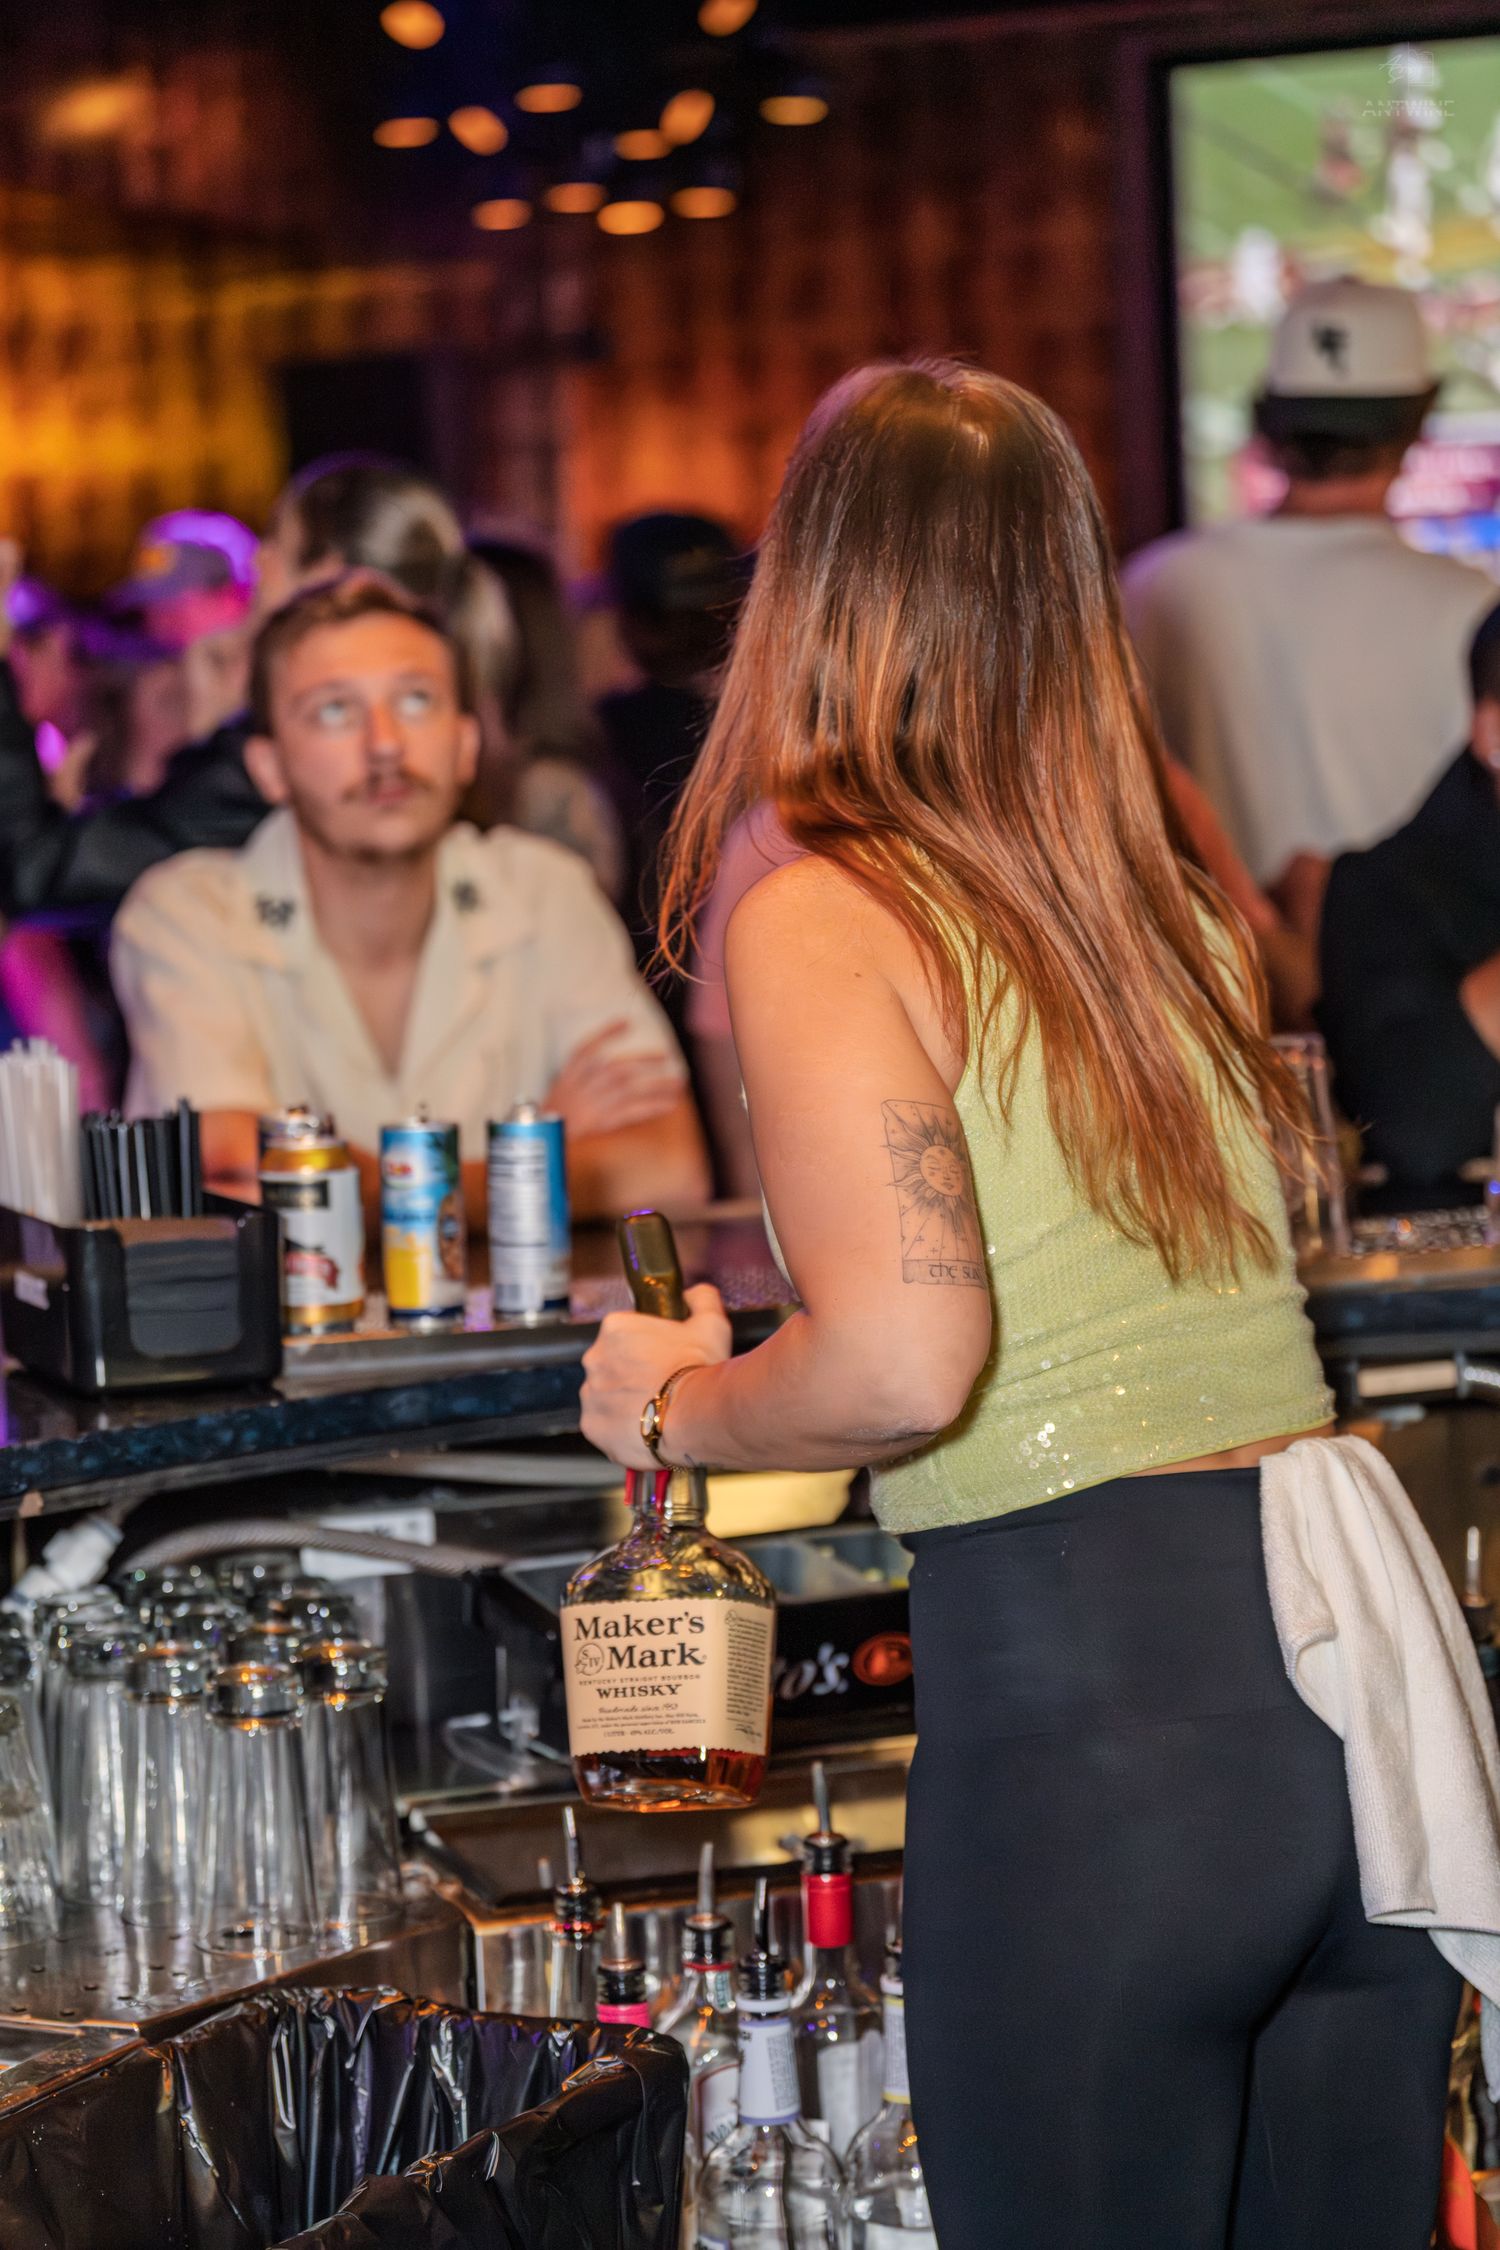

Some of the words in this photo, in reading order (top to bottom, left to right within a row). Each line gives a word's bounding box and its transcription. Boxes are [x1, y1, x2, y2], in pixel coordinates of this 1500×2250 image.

[574, 1611, 705, 1640] Maker's
[606, 1642, 705, 1670] Mark
[596, 1684, 682, 1699] WHISKY
